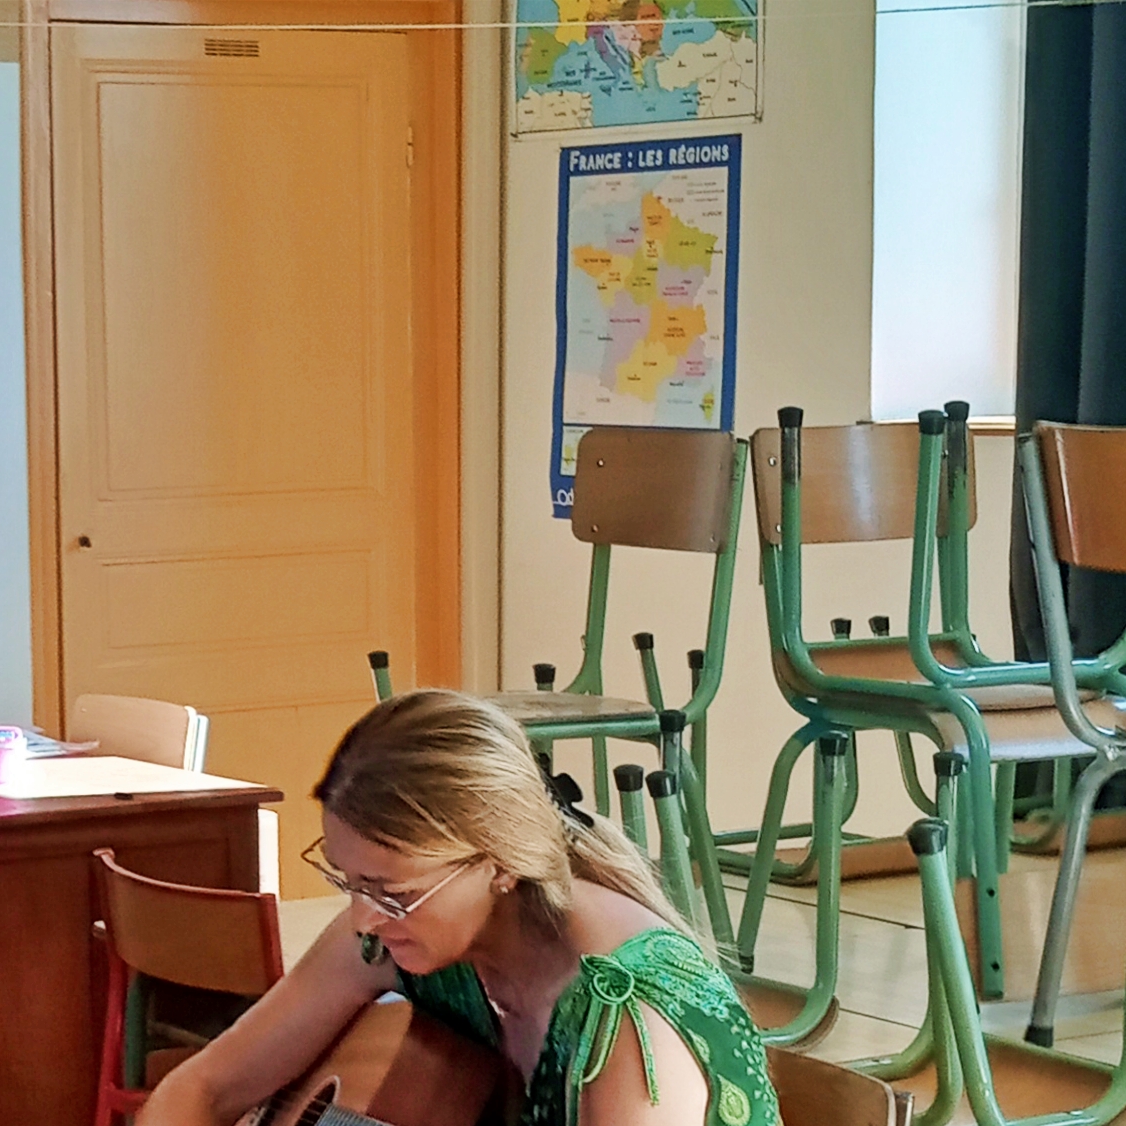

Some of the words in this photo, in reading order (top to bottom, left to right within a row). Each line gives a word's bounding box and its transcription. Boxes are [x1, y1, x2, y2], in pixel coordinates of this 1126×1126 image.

[569, 151, 622, 172] FRANCE
[638, 150, 663, 168] LES
[669, 144, 730, 166] RÉGIONS
